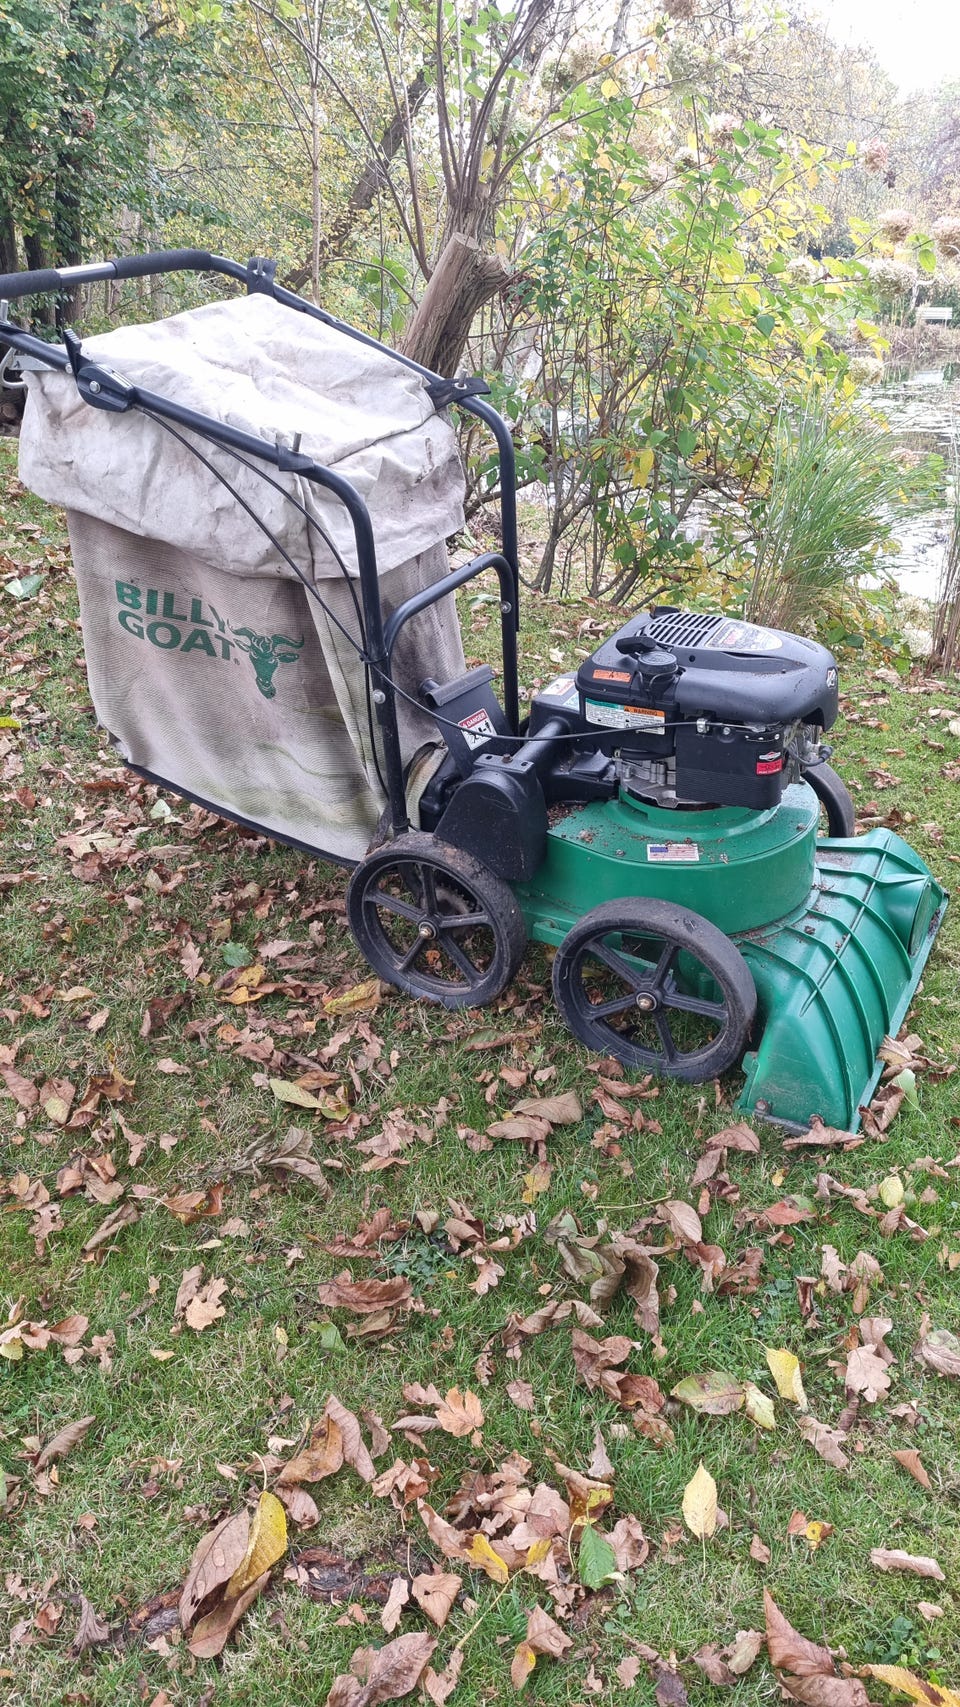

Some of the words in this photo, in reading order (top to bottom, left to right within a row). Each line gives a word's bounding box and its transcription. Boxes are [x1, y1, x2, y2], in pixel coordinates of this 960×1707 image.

[115, 580, 225, 633] BILLY
[466, 712, 487, 727] DANGER
[633, 708, 658, 716] WARNING
